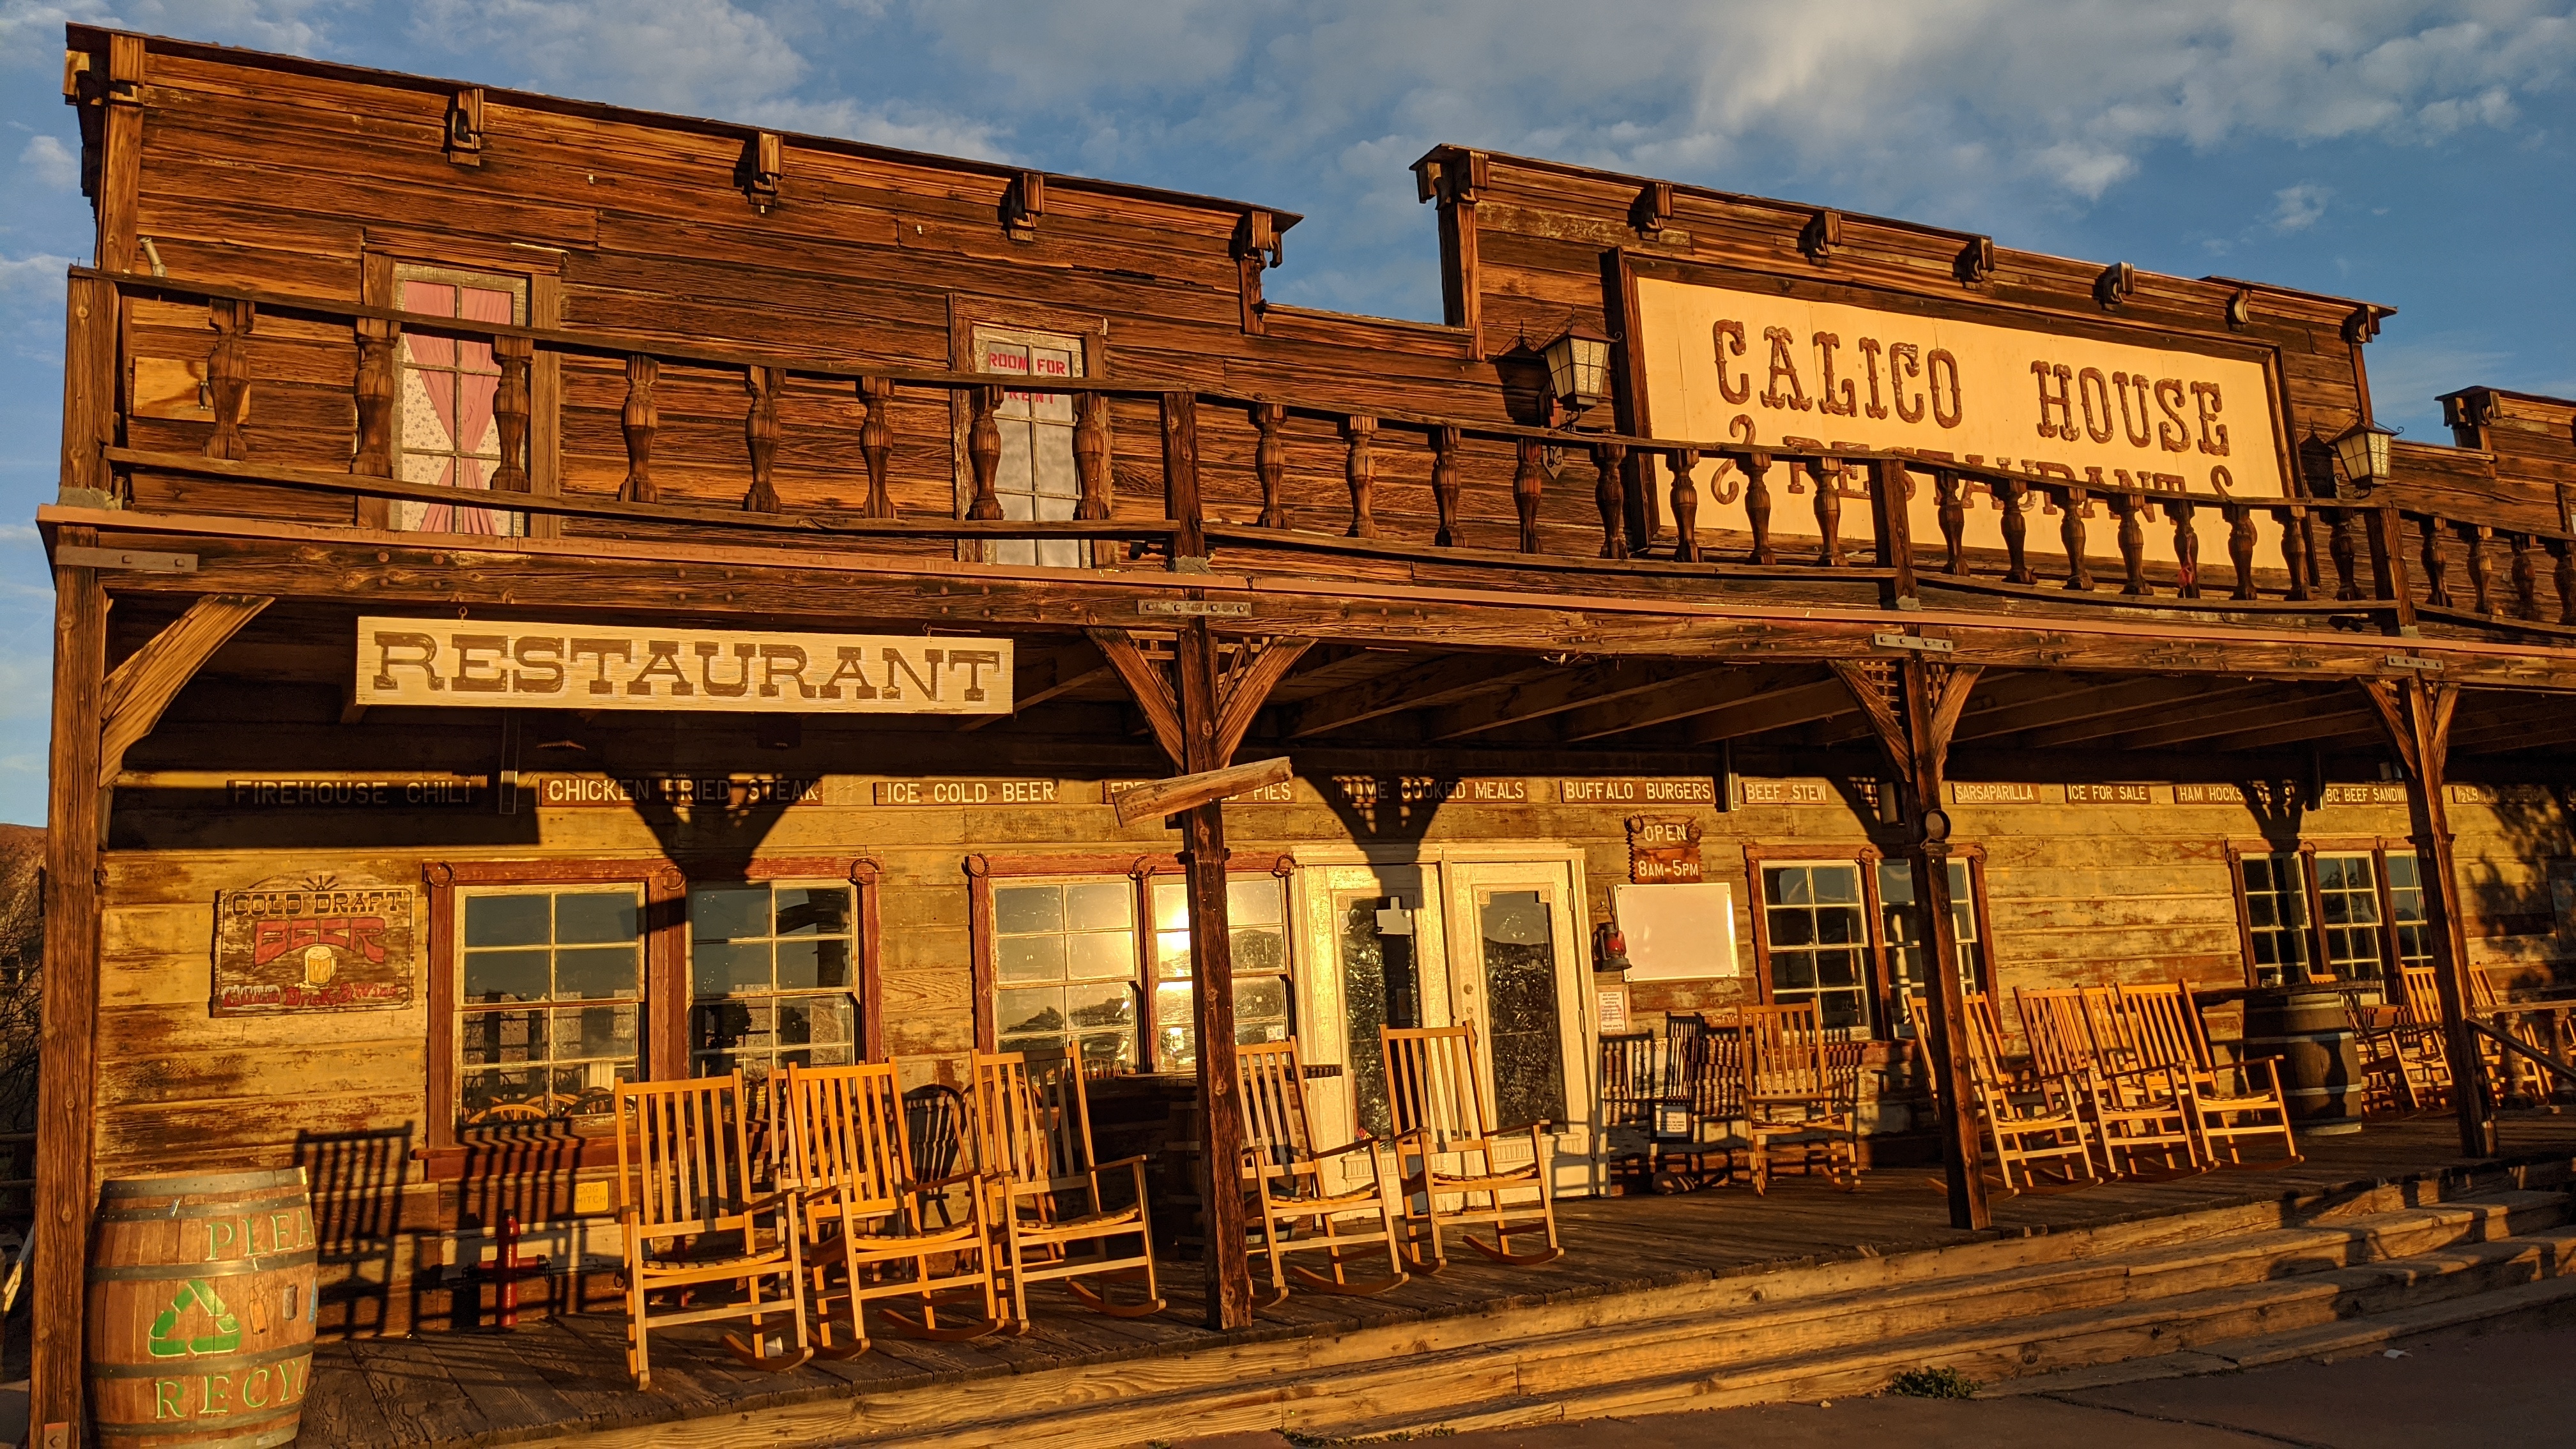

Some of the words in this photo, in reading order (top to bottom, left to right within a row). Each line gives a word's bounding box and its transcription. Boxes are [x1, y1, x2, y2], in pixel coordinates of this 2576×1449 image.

[990, 353, 1028, 370] ROOM
[1038, 358, 1066, 375] FOR
[1712, 319, 1963, 429] CALICO
[2030, 360, 2230, 457] HOUSE
[1783, 436, 2186, 525] RETAURANT
[372, 630, 1000, 703] RESTAURANT
[234, 781, 388, 804] FIREHOUSE
[406, 781, 470, 804] CHILI
[548, 779, 649, 801] CHICKEN
[664, 779, 730, 801] FRIED
[747, 779, 818, 801] STEAK
[887, 782, 920, 802] ICE
[933, 782, 988, 802] COLD
[1002, 781, 1055, 801] BEER
[1253, 782, 1292, 801] PIES
[1341, 781, 1388, 799] HOME
[1401, 781, 1466, 799] COOKED
[1475, 781, 1524, 799] MEALS
[1565, 782, 1634, 800] BUFFALO
[1646, 781, 1712, 801] BURGERS
[1746, 784, 1781, 801] BEEF
[1792, 784, 1827, 801] STEW
[1956, 785, 2034, 801] SARSAPARILLA
[2068, 785, 2087, 801] ICE
[2092, 785, 2113, 801] FOR
[2120, 785, 2147, 801] SALE
[2180, 786, 2203, 801] HAM
[2209, 786, 2244, 801] HOCKS
[2326, 788, 2340, 802] BQ
[2343, 788, 2368, 802] BEEF
[2373, 788, 2408, 801] SANDWI
[1644, 824, 1687, 842] OPEN
[1638, 860, 1699, 877] 8AM-5PM
[233, 894, 303, 916] COLD
[314, 891, 402, 915] DRAFT
[254, 916, 386, 968] BEER
[578, 1185, 599, 1193] DOG
[577, 1195, 606, 1204] HITCH
